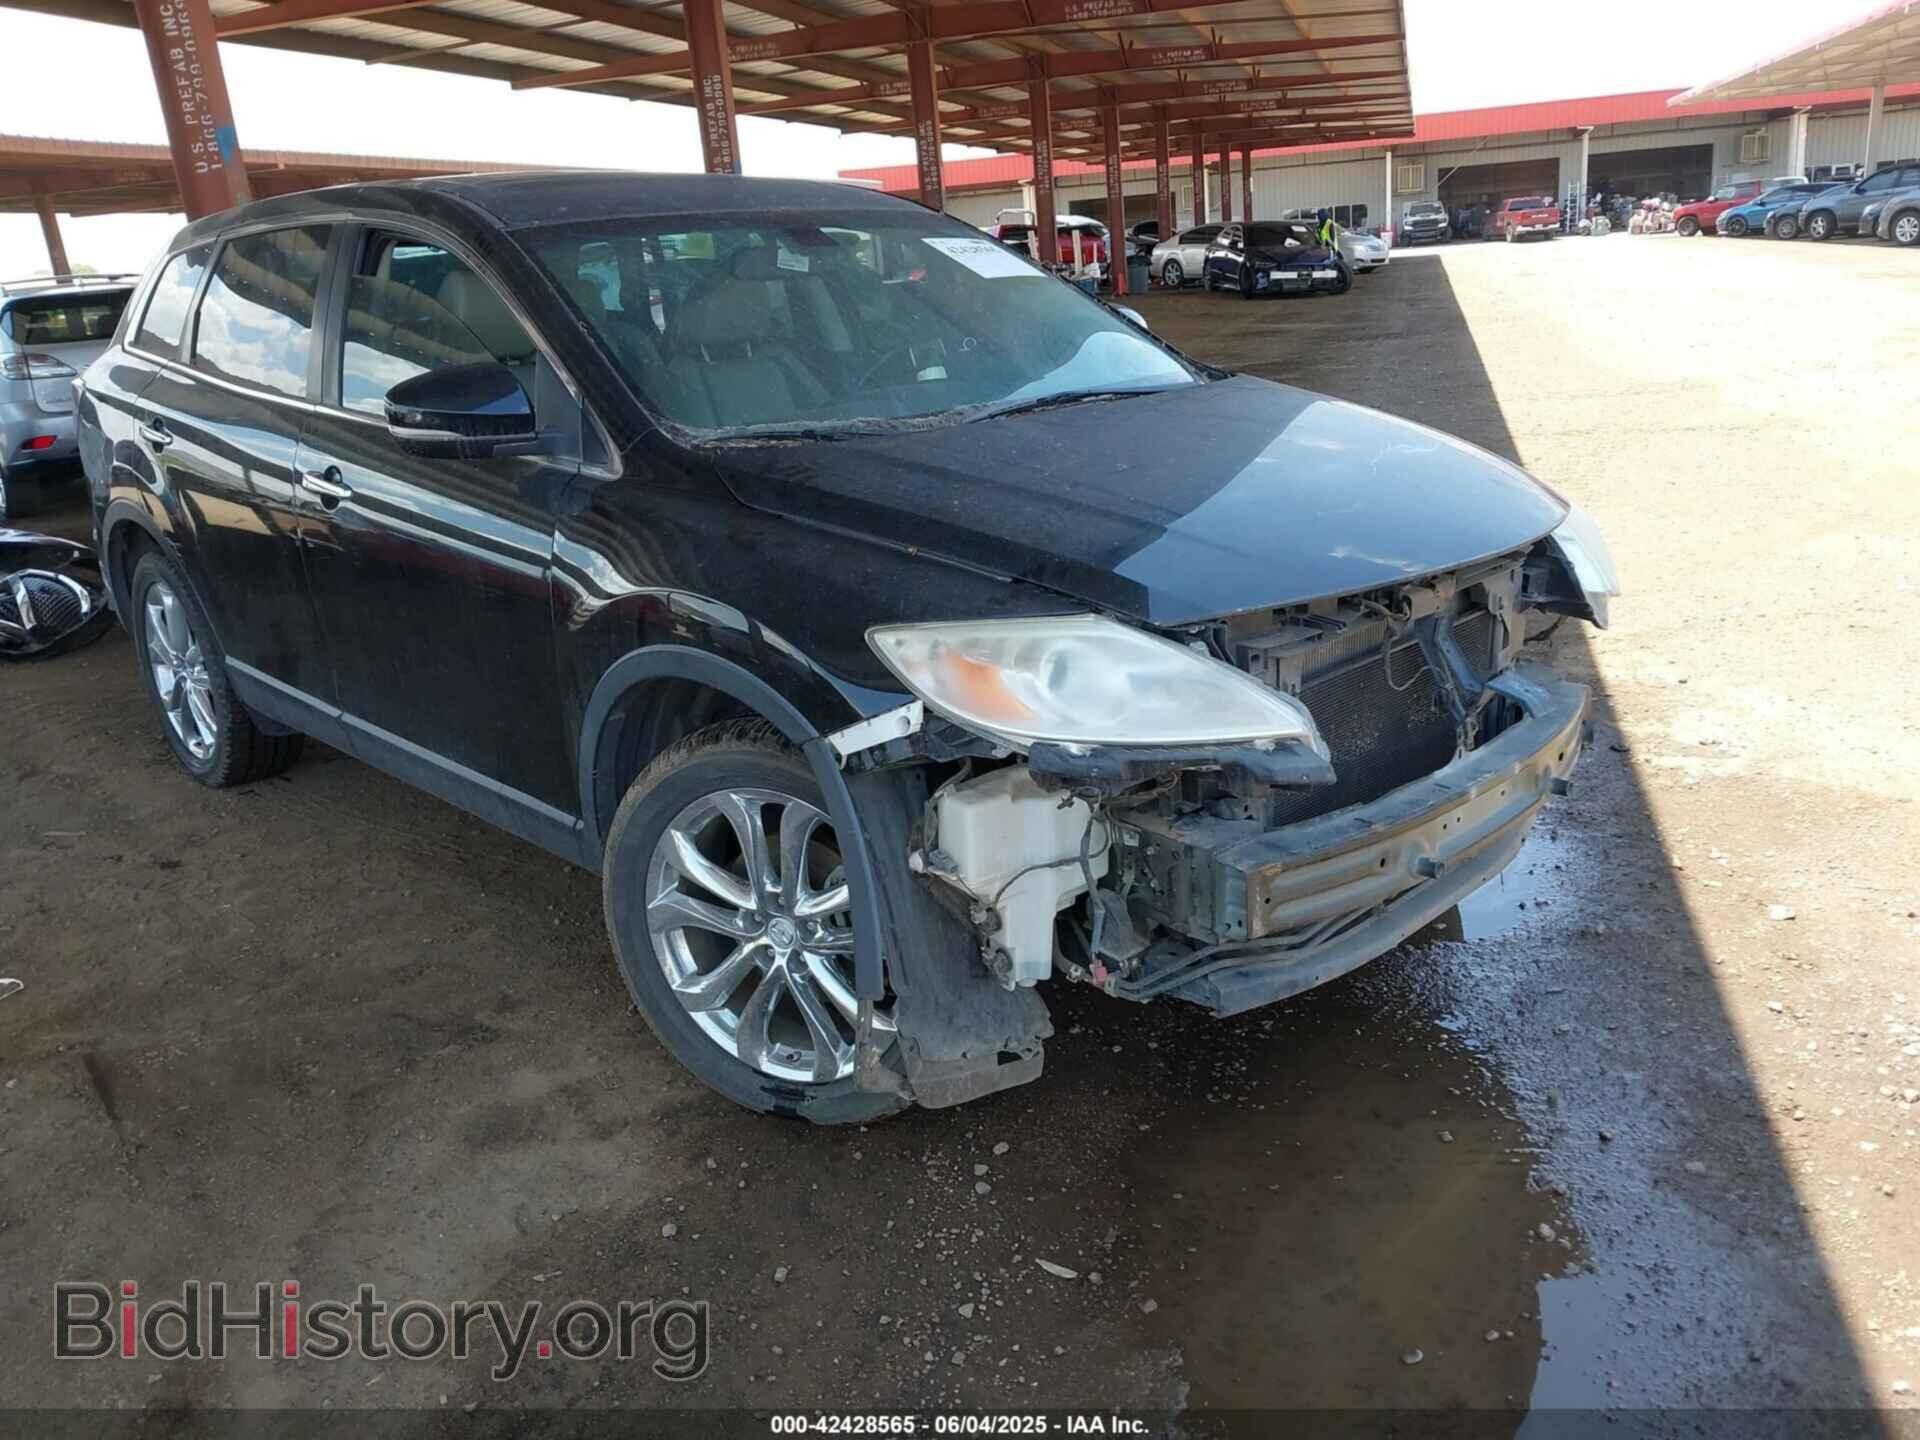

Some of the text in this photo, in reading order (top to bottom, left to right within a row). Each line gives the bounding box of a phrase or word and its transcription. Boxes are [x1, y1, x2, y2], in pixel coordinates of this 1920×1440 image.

[169, 48, 199, 125] PREFAB
[706, 103, 720, 147] PREFAB
[190, 136, 209, 173] U.S.
